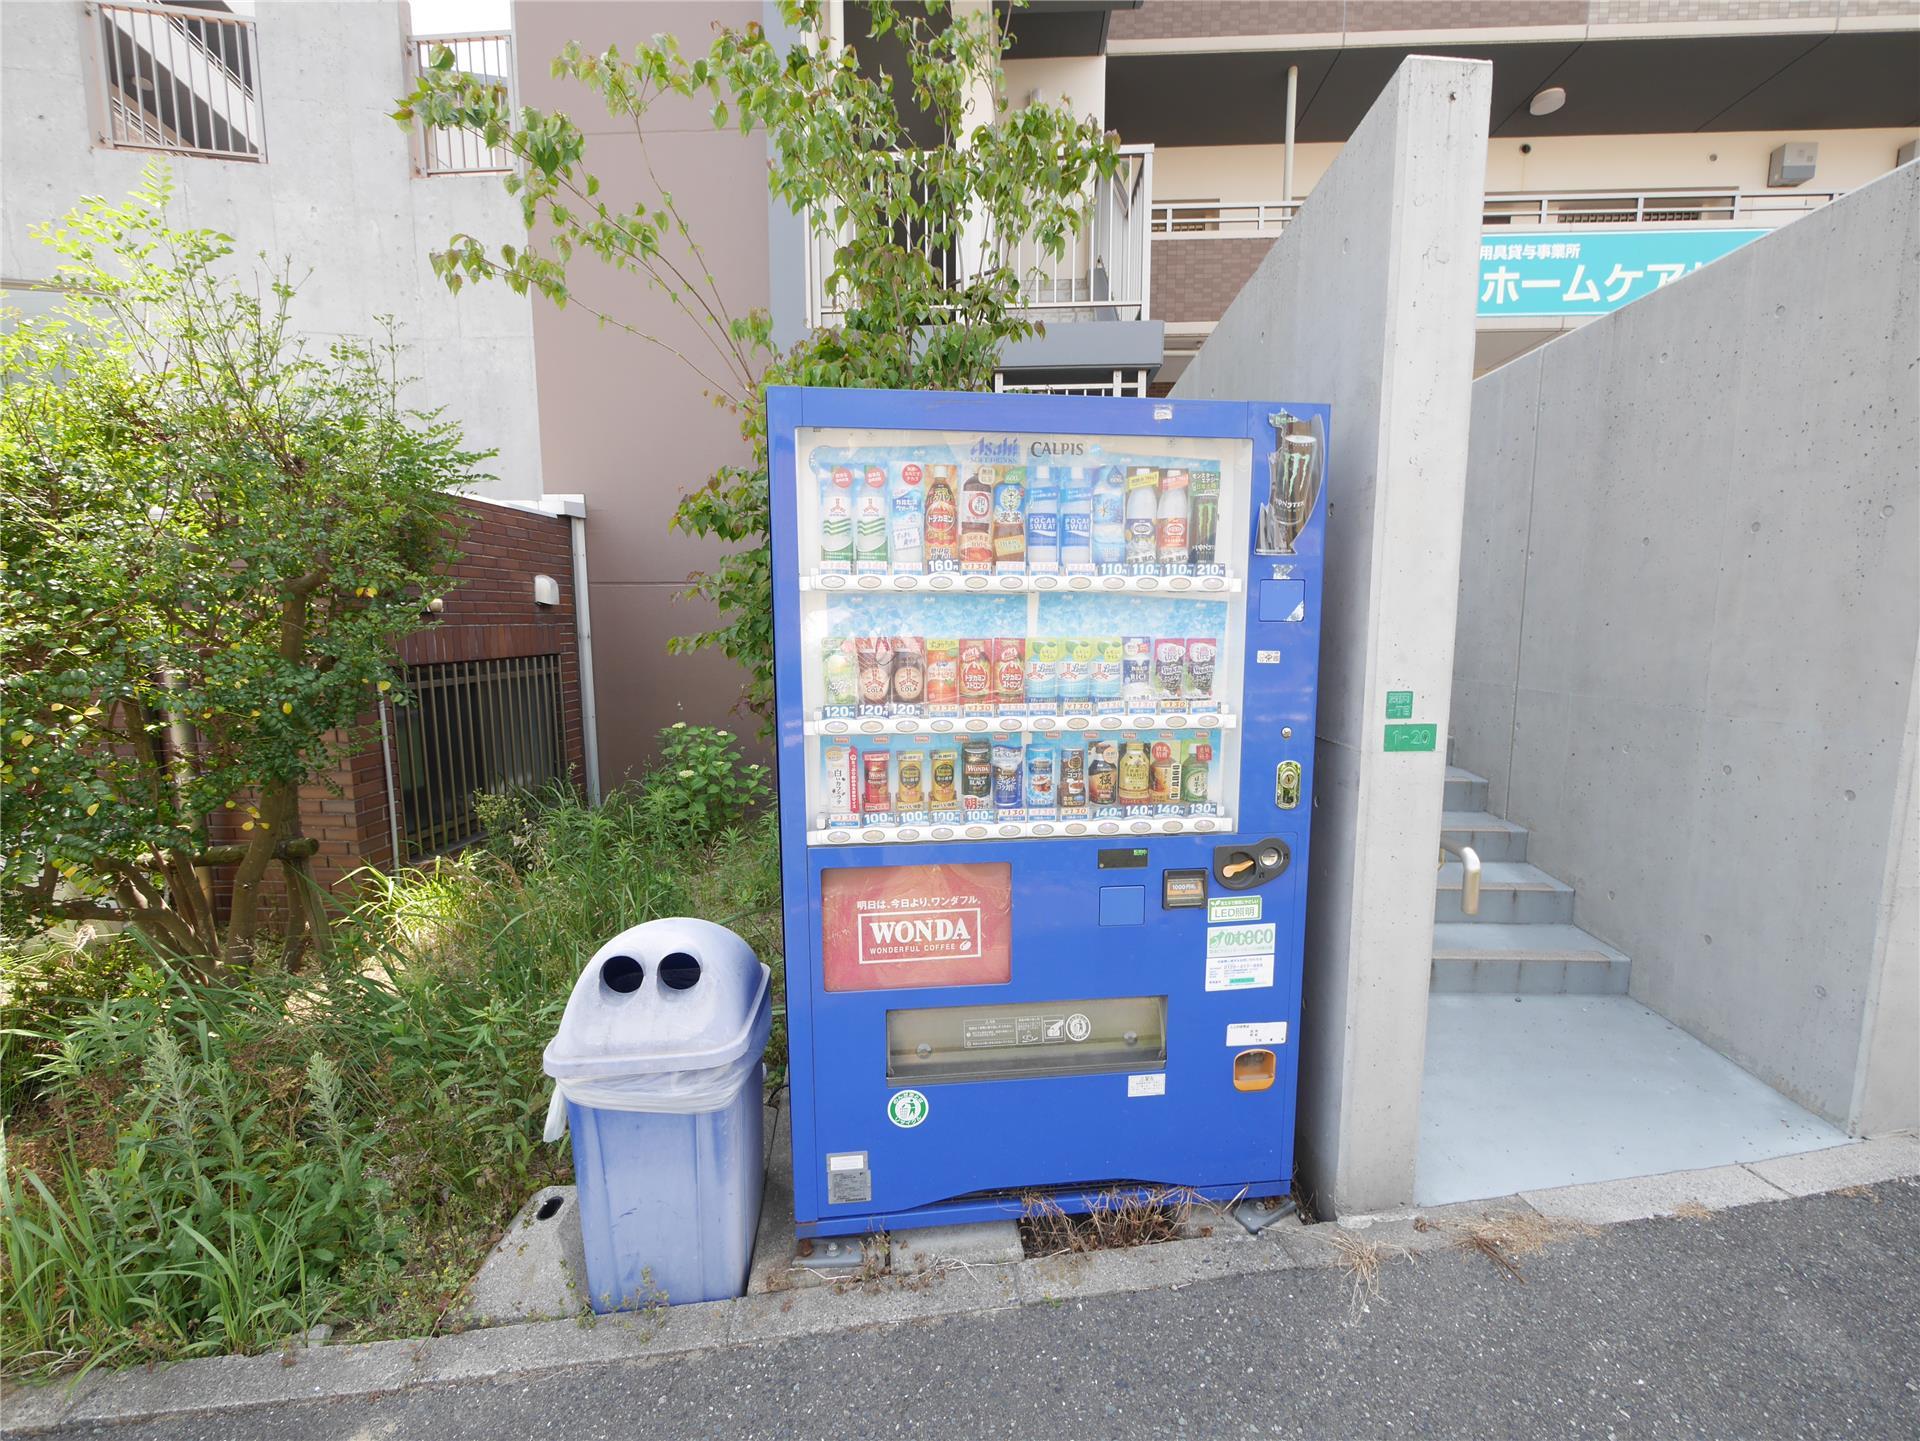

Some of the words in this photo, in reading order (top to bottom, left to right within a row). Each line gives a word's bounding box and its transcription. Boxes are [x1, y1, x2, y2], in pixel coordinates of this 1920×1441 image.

[1481, 261, 1703, 304] ホームケア
[970, 437, 1018, 456] Asahi
[1030, 441, 1084, 457] CALPIS
[1000, 511, 1021, 523] 麦茶
[1392, 729, 1432, 745] 1-20
[1214, 906, 1255, 918] LED照明
[869, 917, 971, 944] WONDA
[869, 945, 921, 955] WONDERFUL
[923, 943, 956, 952] COFFEE
